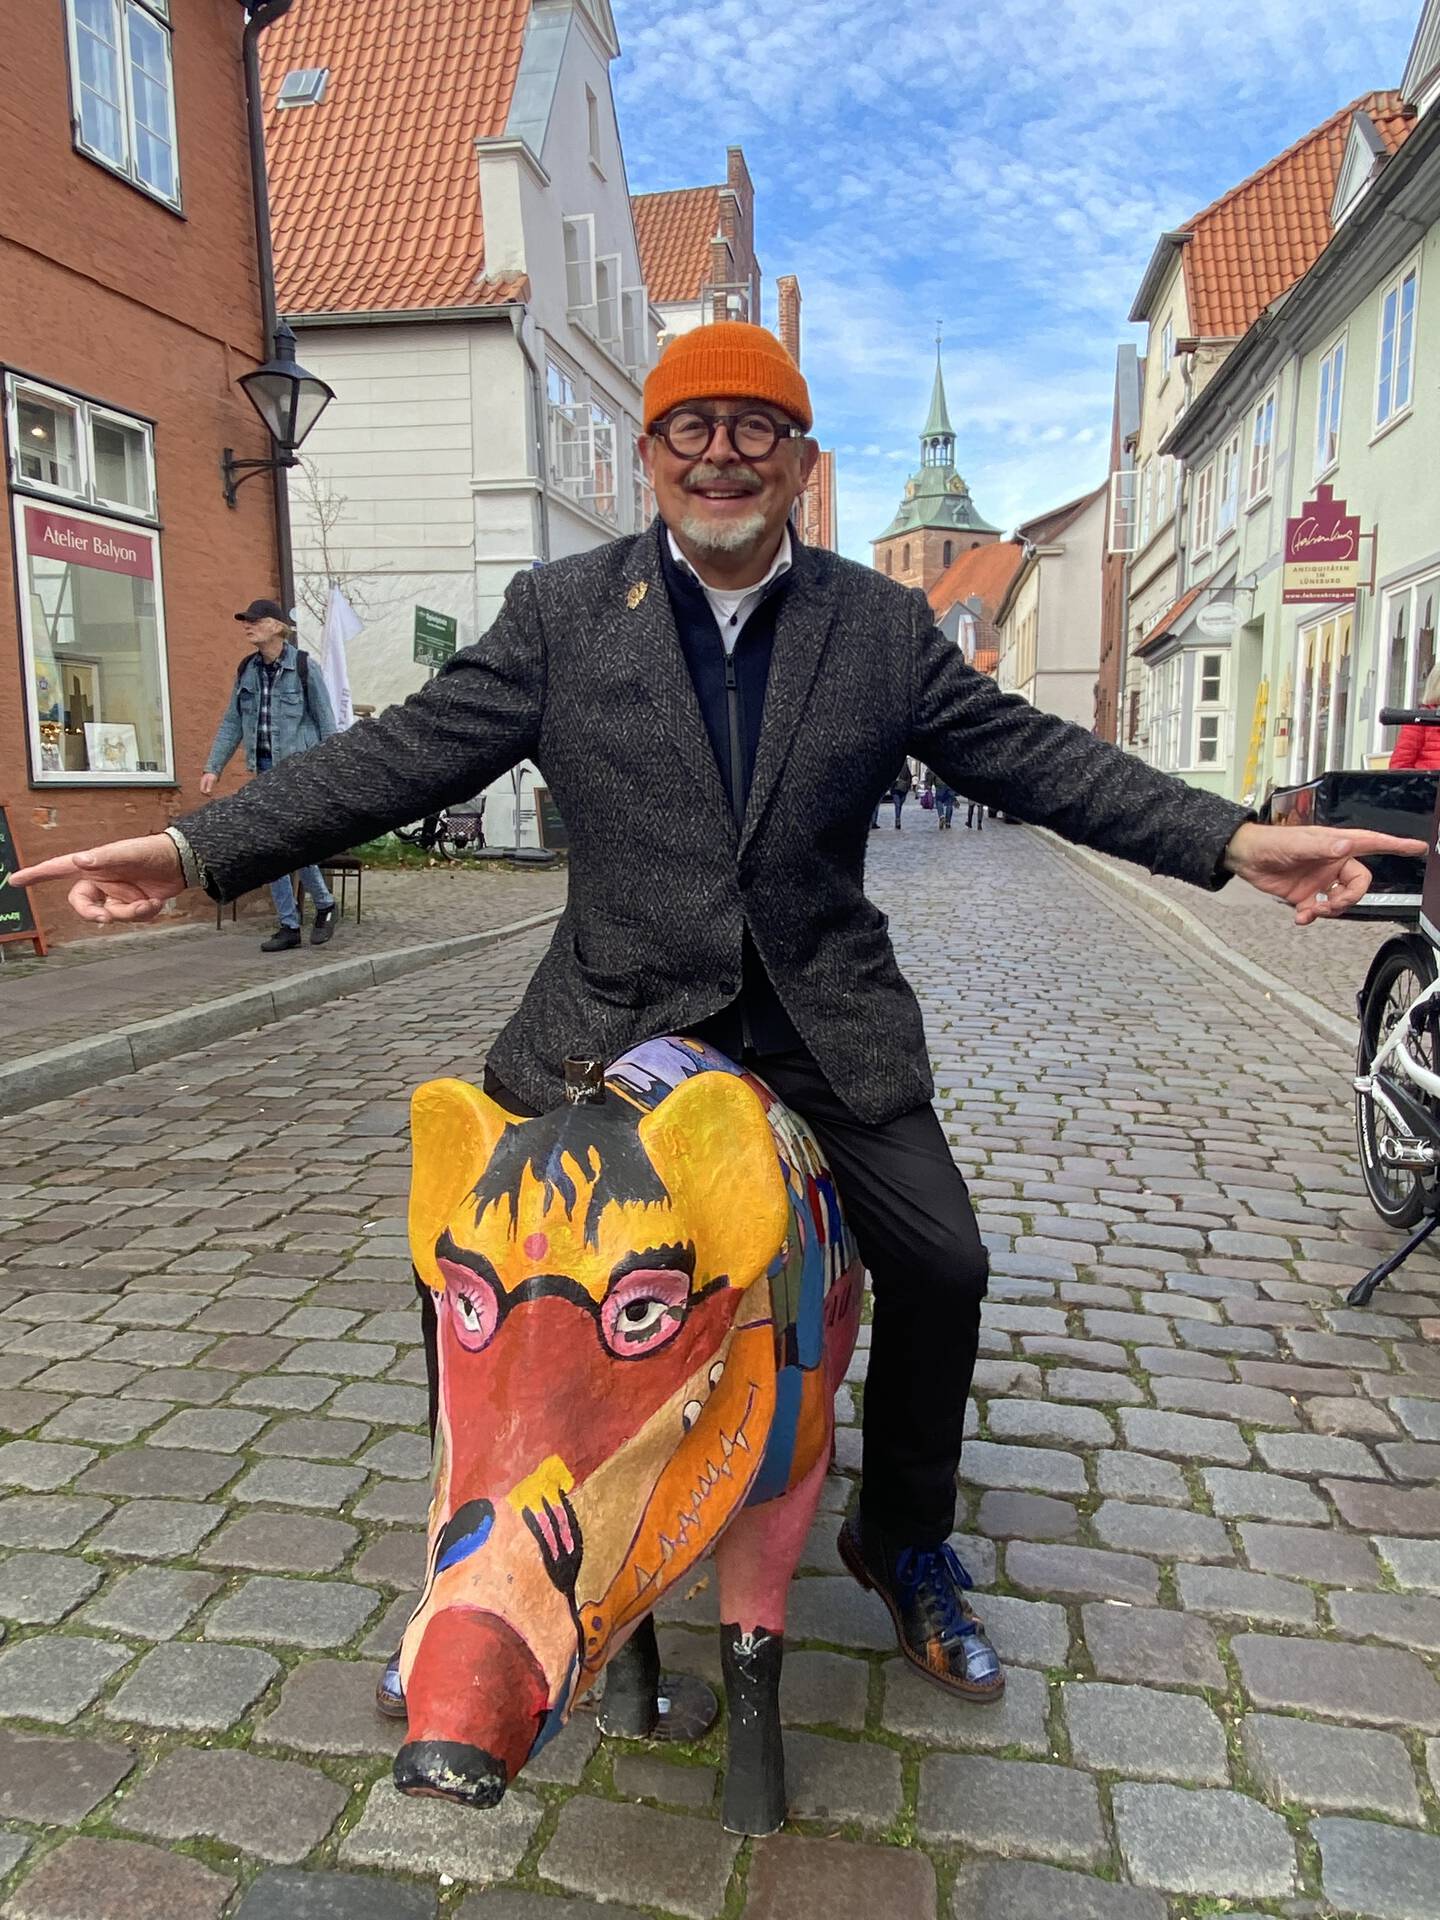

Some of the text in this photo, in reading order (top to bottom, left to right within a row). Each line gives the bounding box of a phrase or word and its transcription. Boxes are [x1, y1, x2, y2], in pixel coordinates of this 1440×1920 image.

[43, 525, 137, 563] Atelier Balyon
[1293, 565, 1349, 573] ANTIQUITÄTEN
